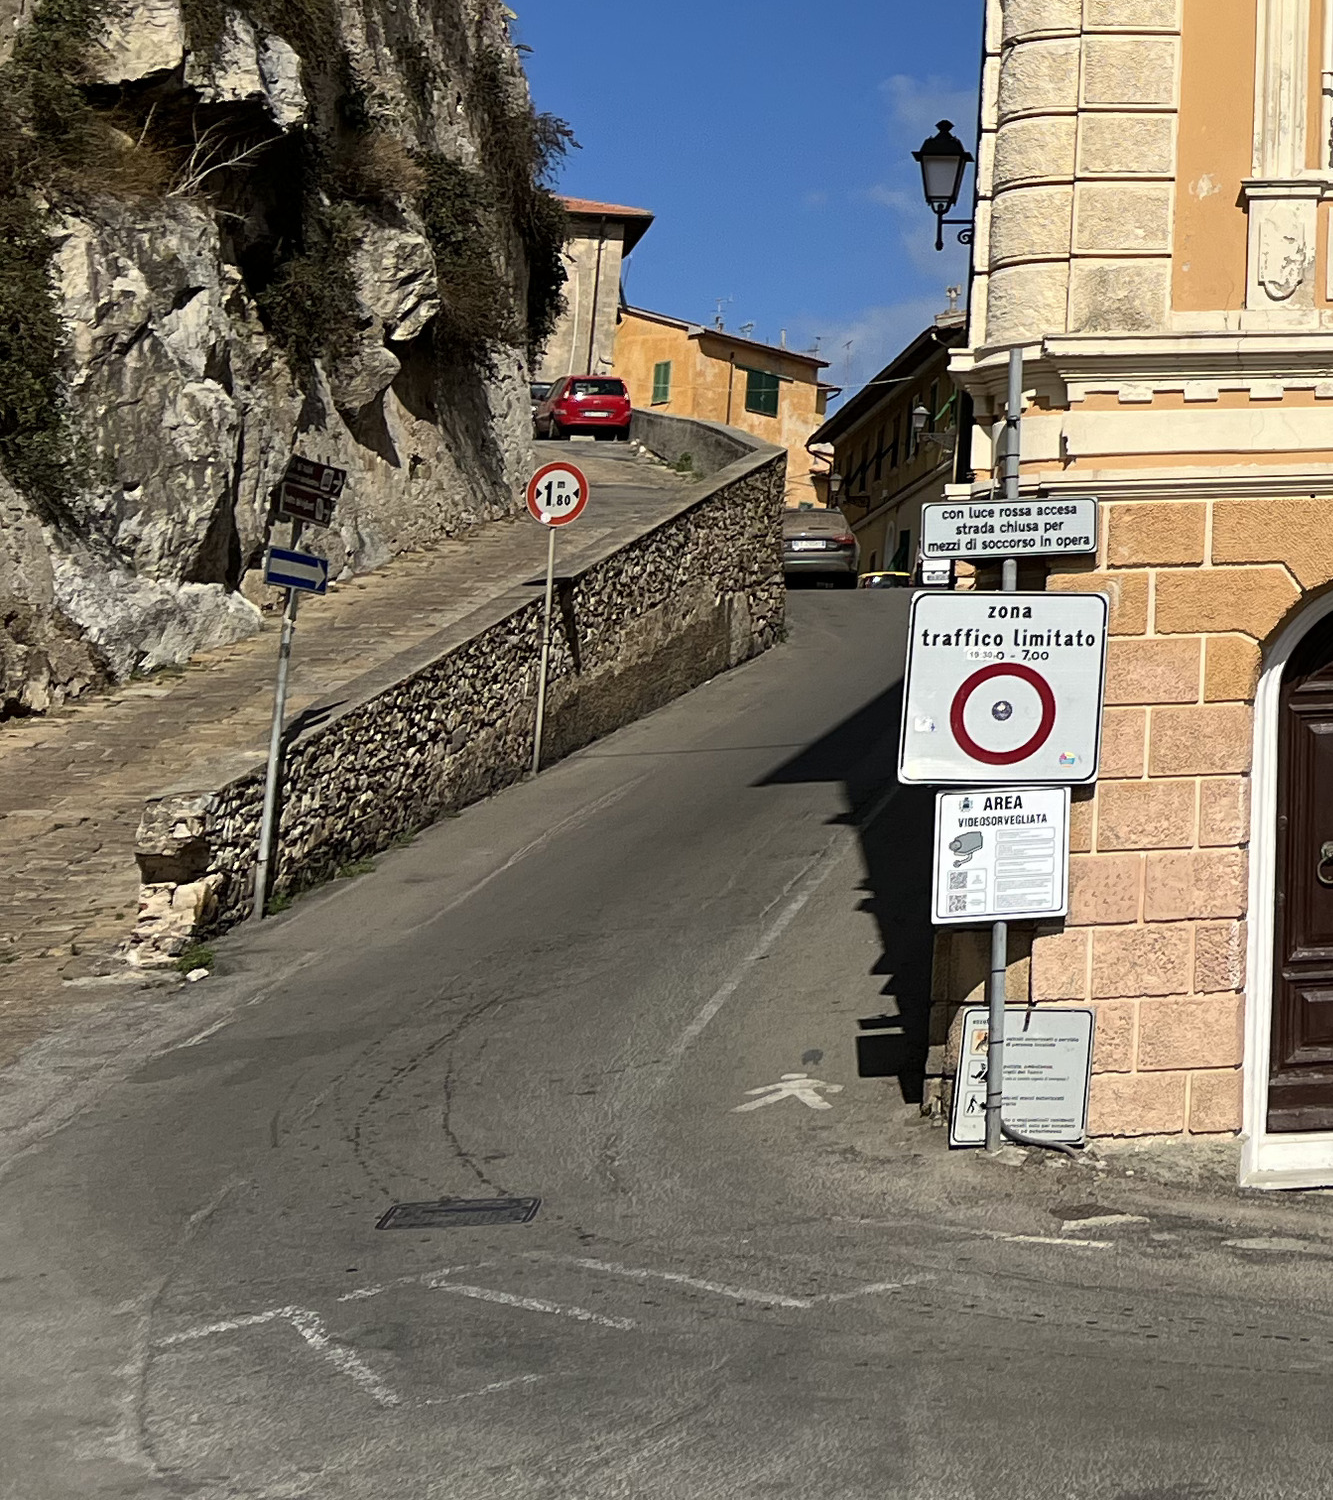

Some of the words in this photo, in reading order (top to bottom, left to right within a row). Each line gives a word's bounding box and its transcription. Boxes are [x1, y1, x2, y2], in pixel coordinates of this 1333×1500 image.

[942, 509, 964, 520] con
[969, 507, 994, 519] luce
[999, 506, 1031, 517] rossa
[1037, 504, 1077, 516] accesa
[956, 521, 994, 535] strada
[999, 521, 1038, 533] chiusa
[1044, 521, 1064, 533] per
[928, 540, 960, 552] mezzi
[965, 538, 976, 550] di
[982, 538, 1035, 549] soccorso
[1040, 535, 1051, 547] in
[1056, 535, 1090, 549] opera
[988, 605, 1032, 619] zona
[922, 628, 1004, 647] traffico
[1014, 629, 1096, 647] limitato
[983, 795, 1023, 811] AREA
[958, 813, 1047, 828] VIDEOSORVEGLIATA
